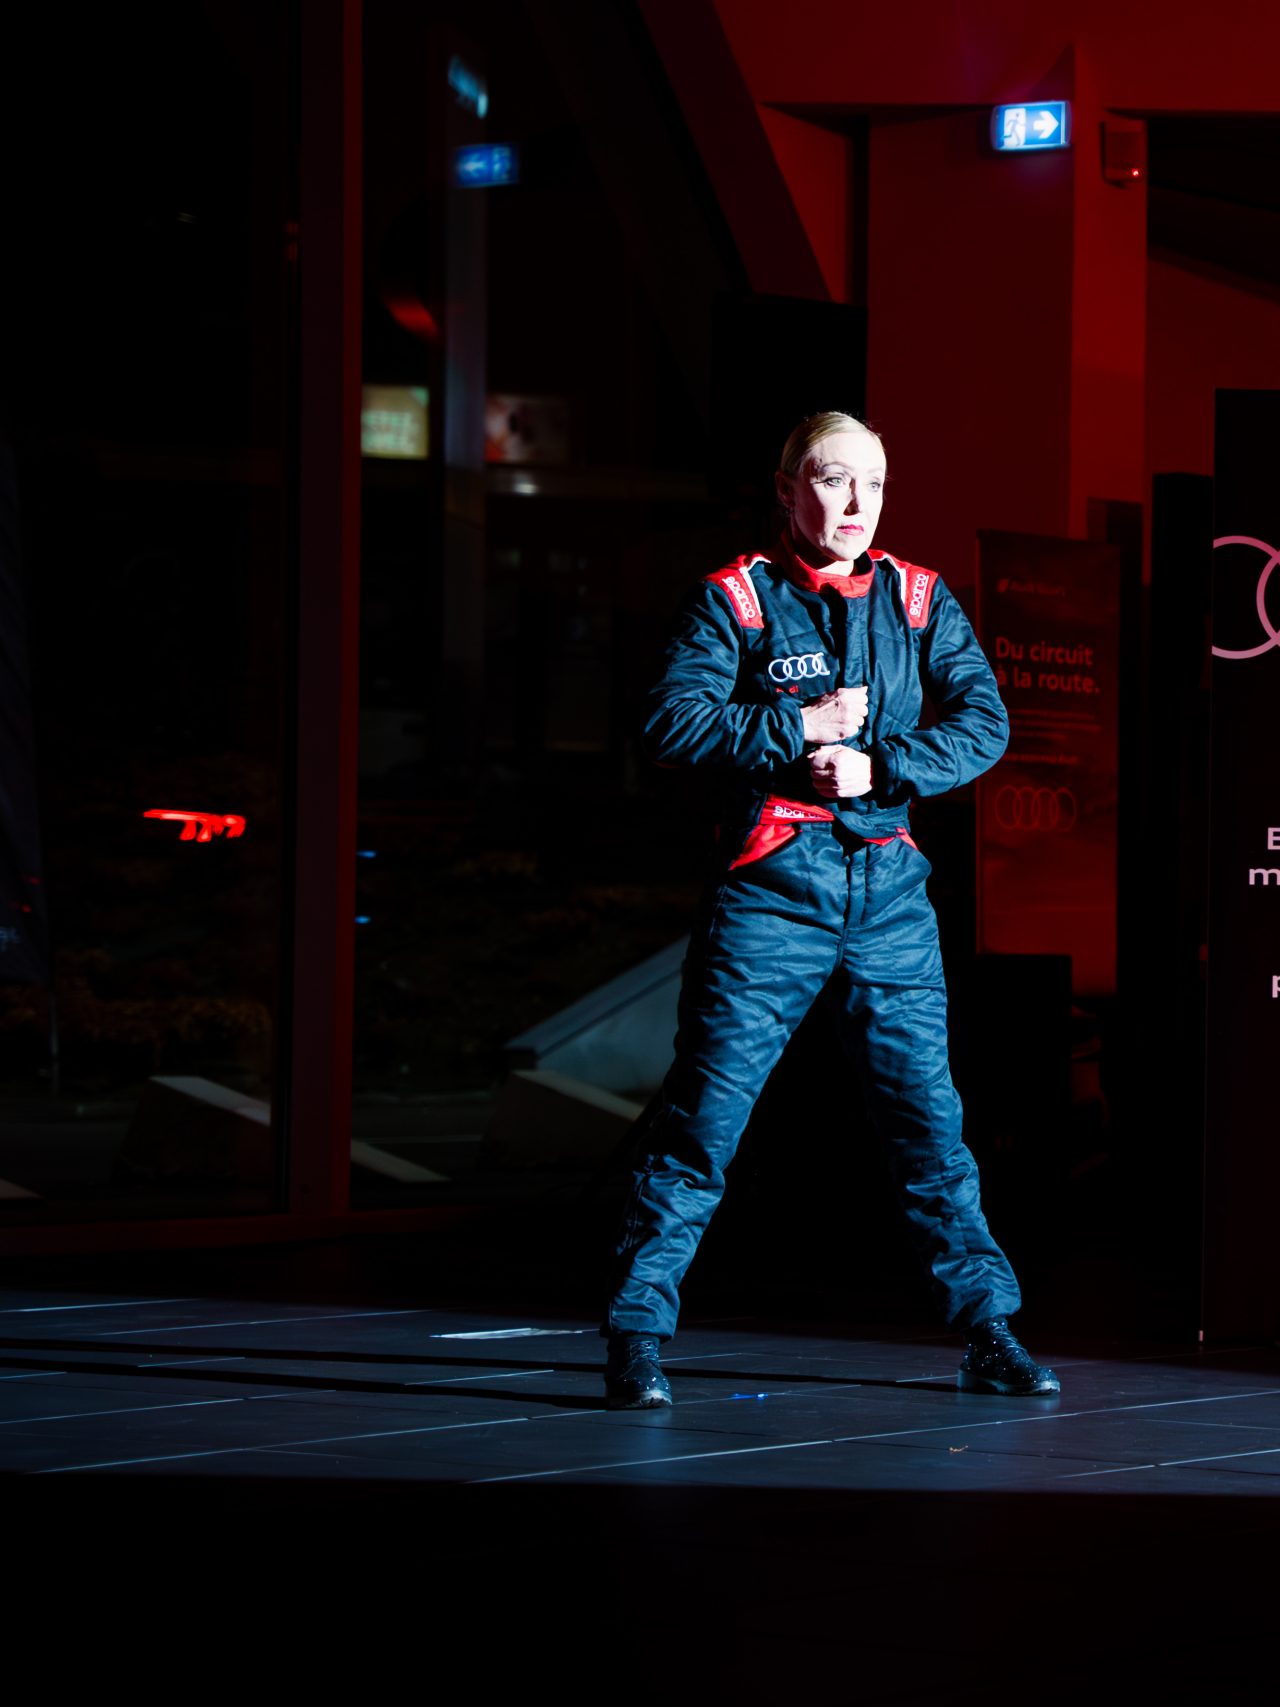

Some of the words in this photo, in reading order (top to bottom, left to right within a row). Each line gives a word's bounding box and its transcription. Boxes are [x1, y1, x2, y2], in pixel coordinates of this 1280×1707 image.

[995, 636, 1024, 661] Du
[1029, 640, 1094, 667] circuit
[1012, 665, 1032, 689] la
[1037, 672, 1102, 695] route.
